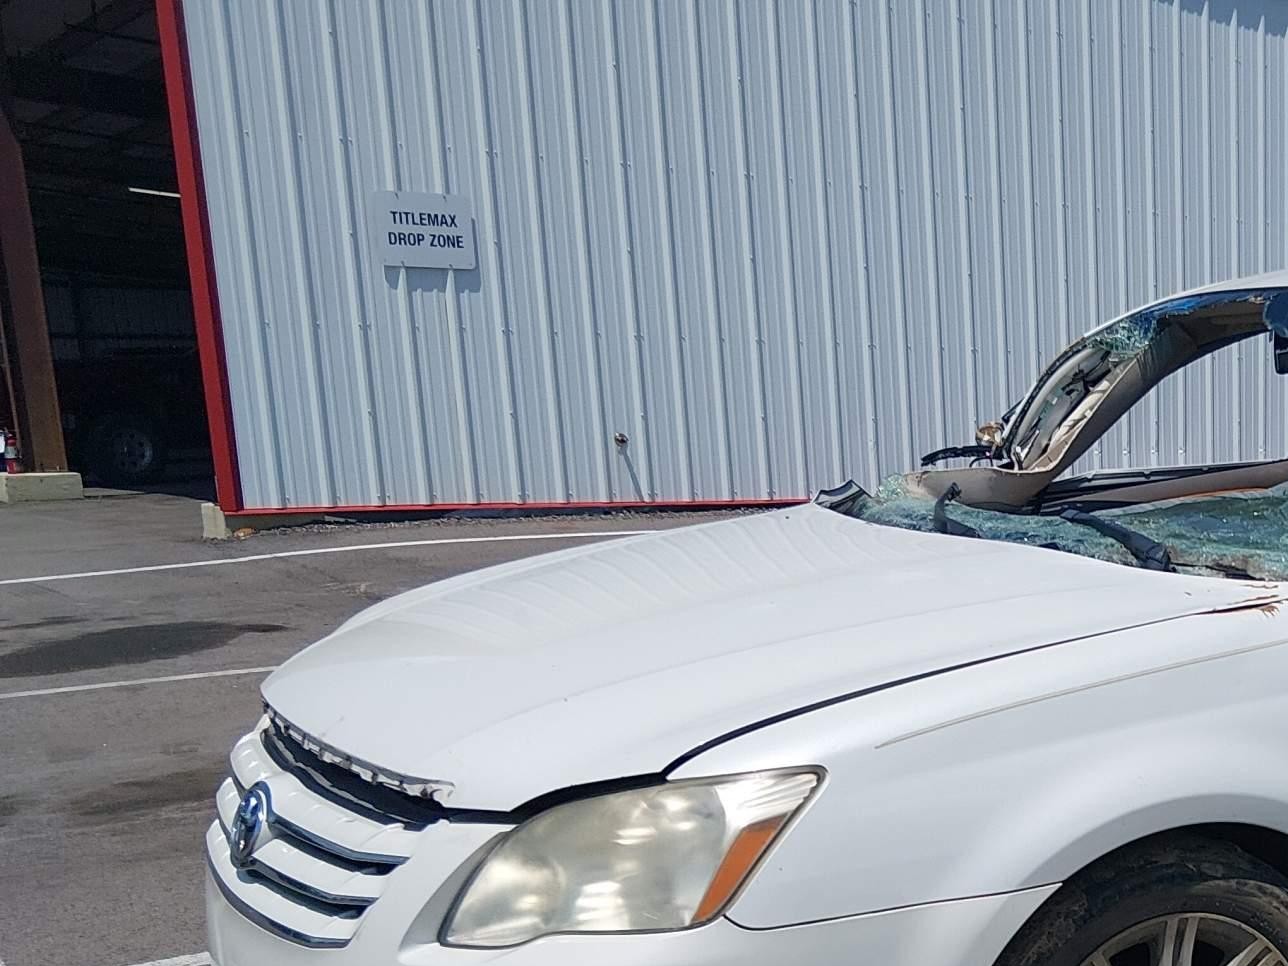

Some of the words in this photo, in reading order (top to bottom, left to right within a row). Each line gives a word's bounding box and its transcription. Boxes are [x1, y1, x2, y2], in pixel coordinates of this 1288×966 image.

[390, 211, 458, 228] TITLEMAX
[388, 232, 425, 246] DROP
[429, 234, 464, 249] ZONE
